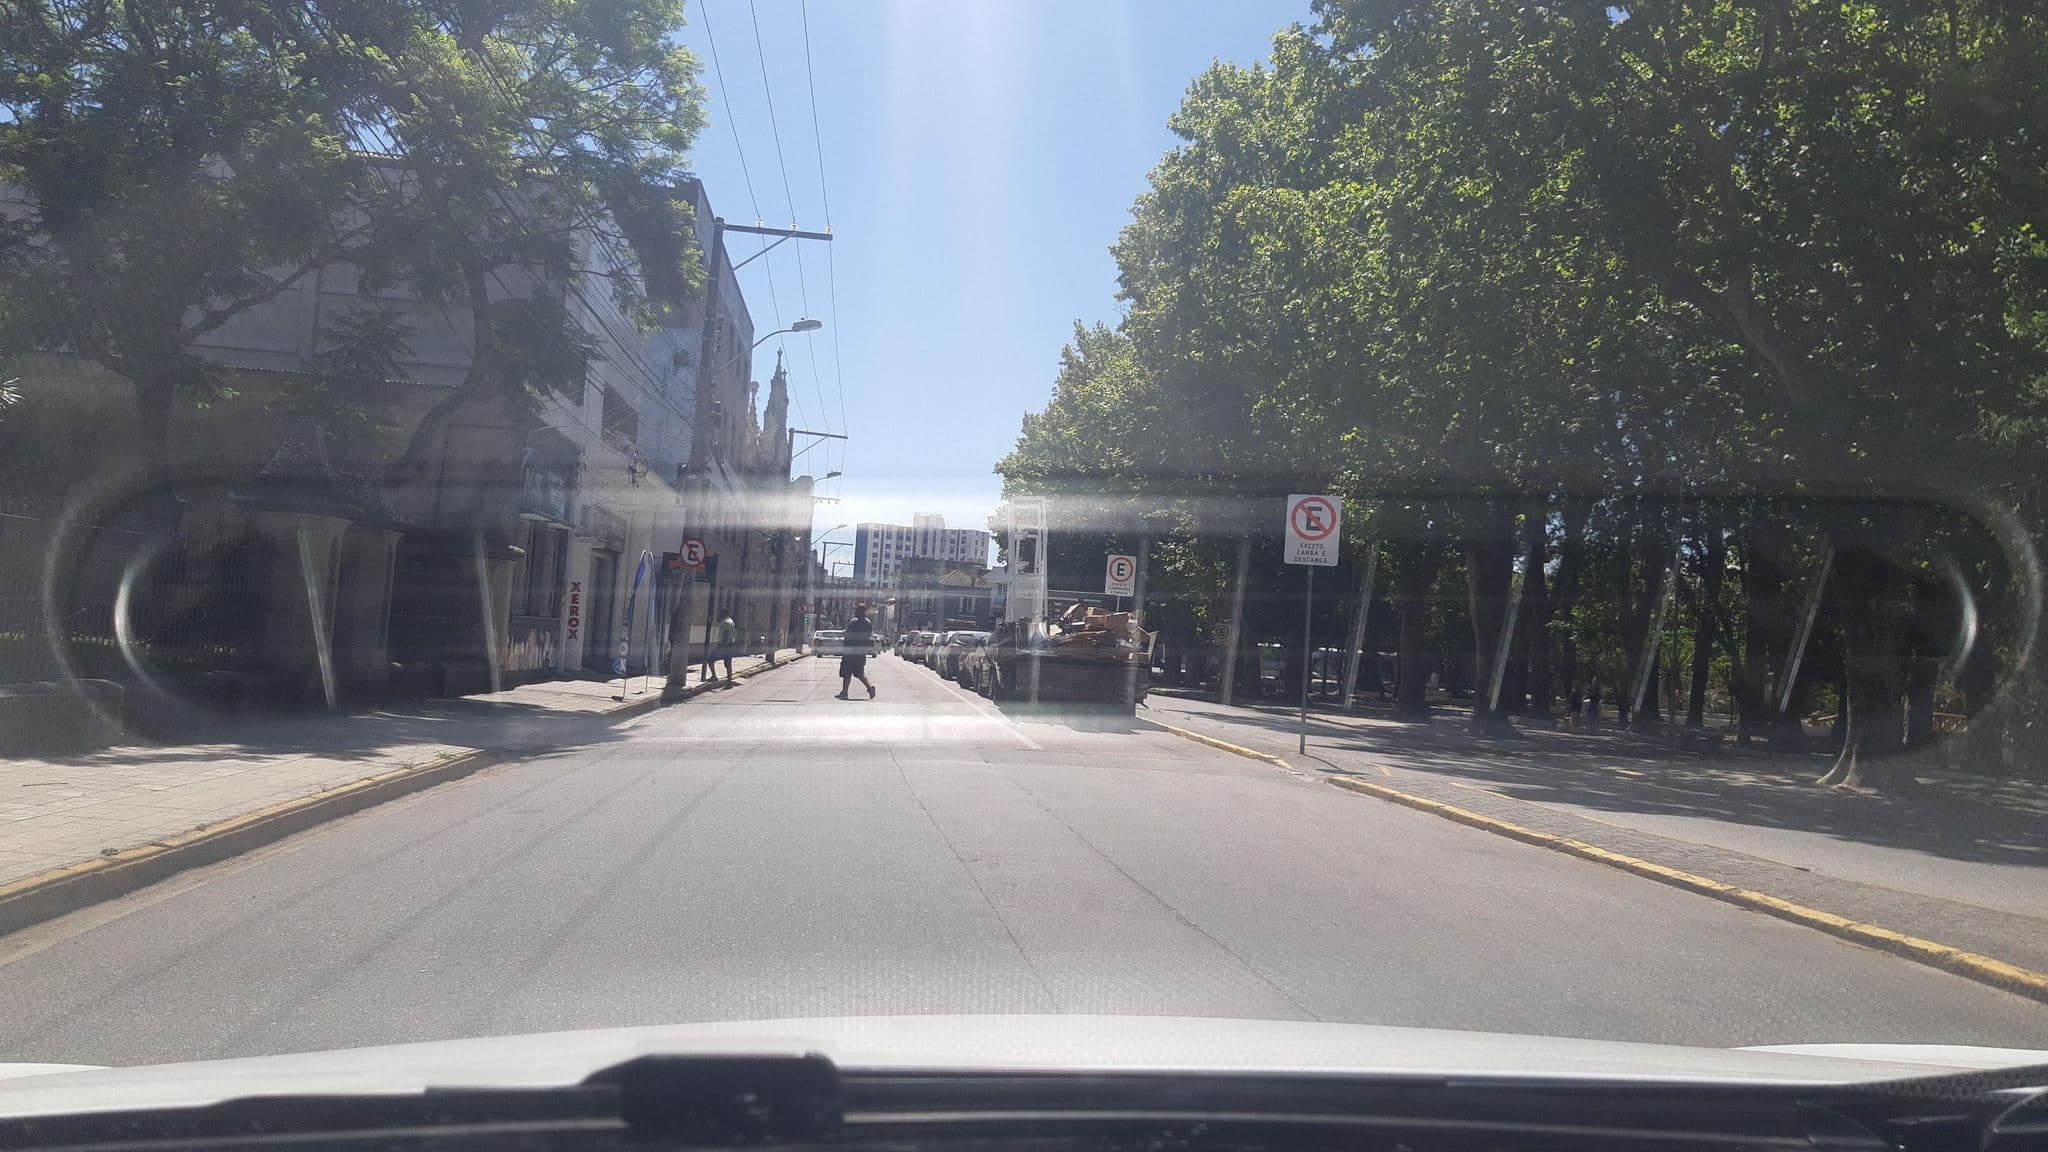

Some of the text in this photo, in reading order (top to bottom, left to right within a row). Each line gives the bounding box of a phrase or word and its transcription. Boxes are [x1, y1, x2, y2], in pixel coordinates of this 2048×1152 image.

[1305, 506, 1323, 532] E
[1300, 542, 1325, 550] EXCETO
[1296, 549, 1319, 557] CARGA
[1293, 556, 1328, 564] DESCARGA
[1116, 562, 1126, 577] E
[567, 581, 581, 640] XEROX
